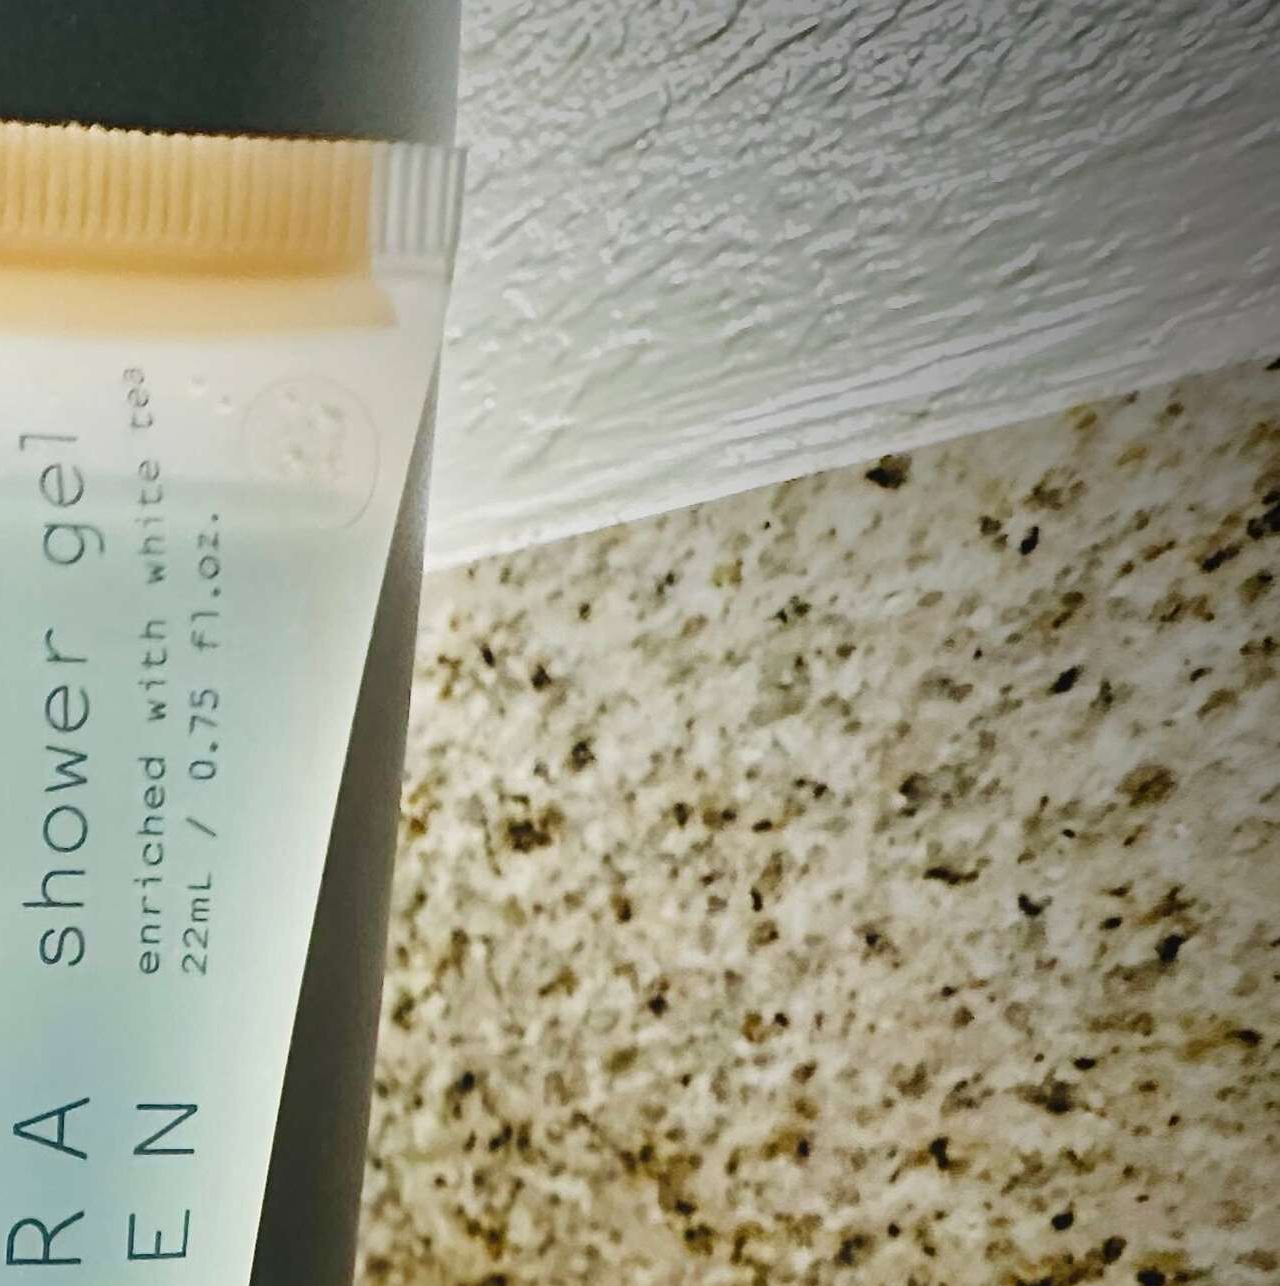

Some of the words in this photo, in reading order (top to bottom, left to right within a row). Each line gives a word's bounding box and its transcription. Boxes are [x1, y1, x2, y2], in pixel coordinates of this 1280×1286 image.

[19, 433, 105, 566] gel
[134, 459, 166, 585] white
[137, 617, 167, 723] with
[189, 688, 220, 781] 0.75
[22, 628, 91, 968] shower
[185, 817, 218, 839] /
[134, 756, 166, 975] enriched
[182, 874, 214, 976] 22mL
